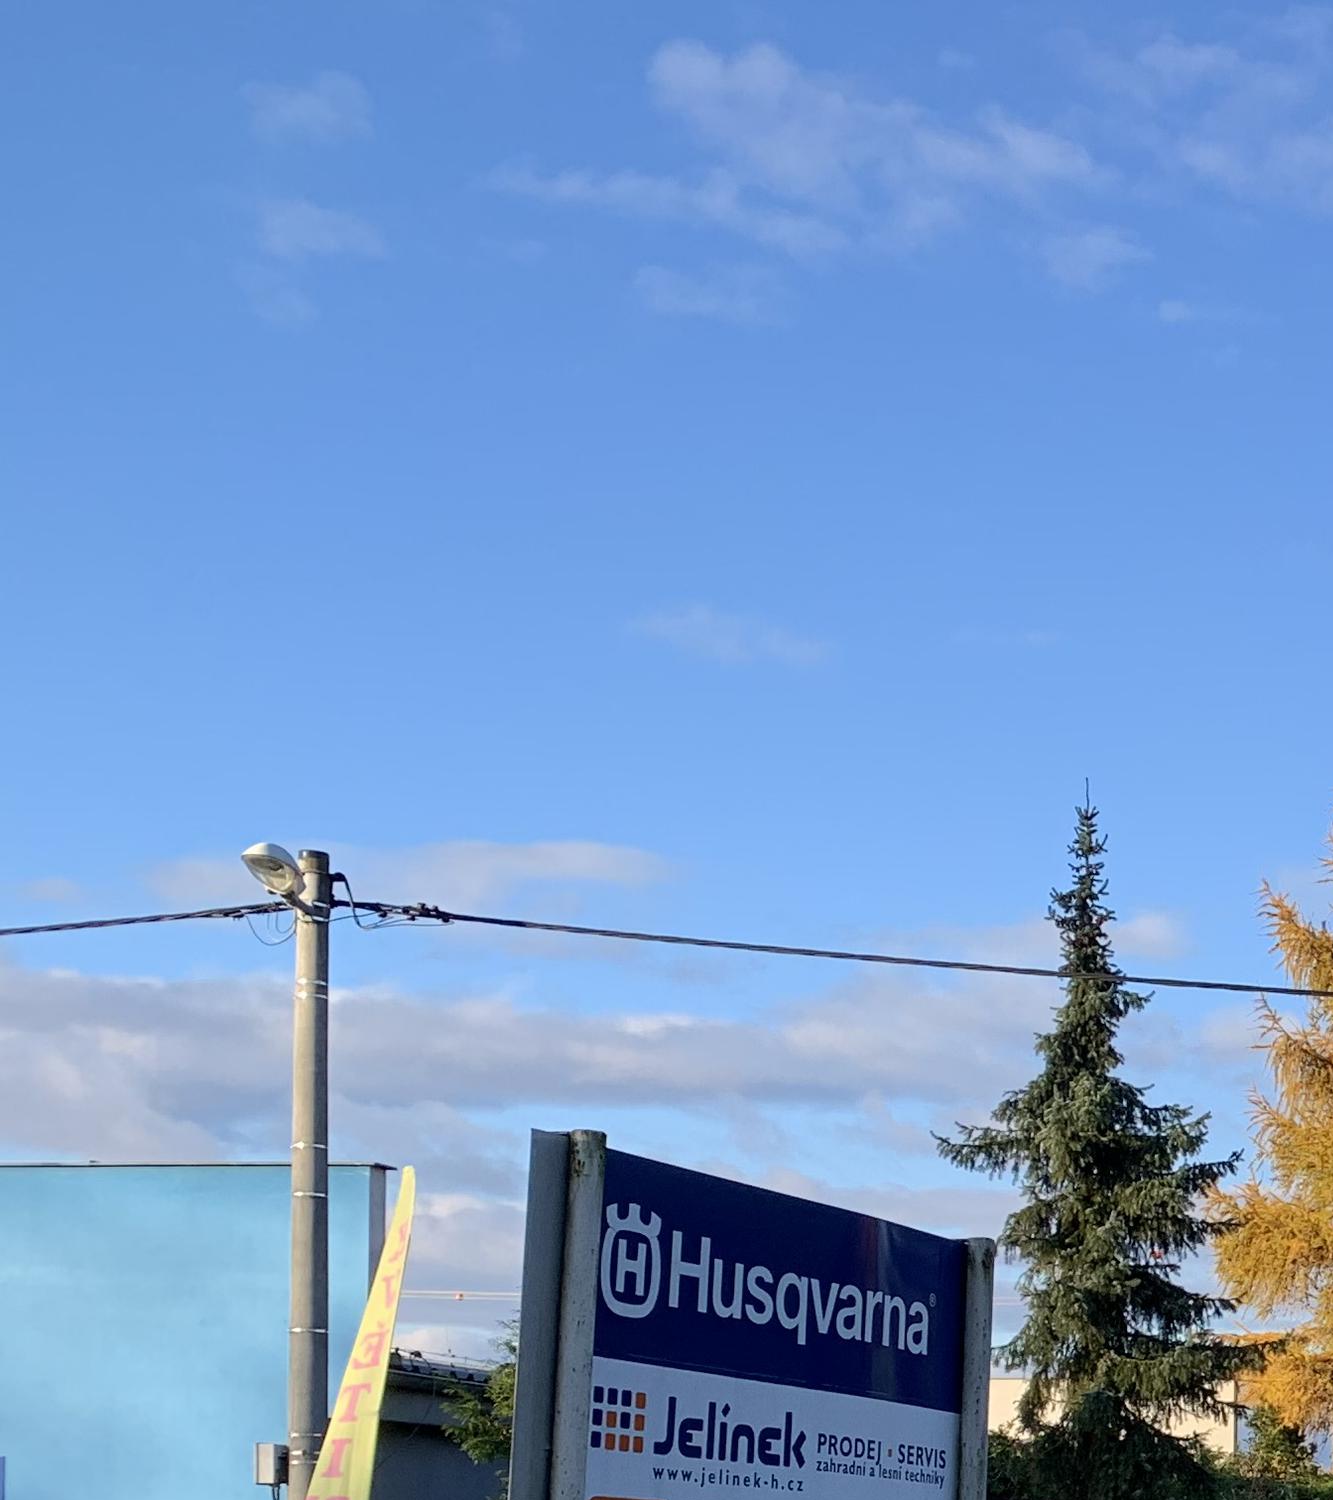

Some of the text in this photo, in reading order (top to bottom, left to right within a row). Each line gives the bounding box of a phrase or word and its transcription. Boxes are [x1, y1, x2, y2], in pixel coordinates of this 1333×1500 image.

[668, 1230, 929, 1355] Husqvarna
[816, 1433, 947, 1469] PRODEJ SERVIS
[653, 1467, 804, 1491] www.jelinek-h.cz
[869, 1467, 875, 1477] a
[905, 1468, 945, 1489] techniky
